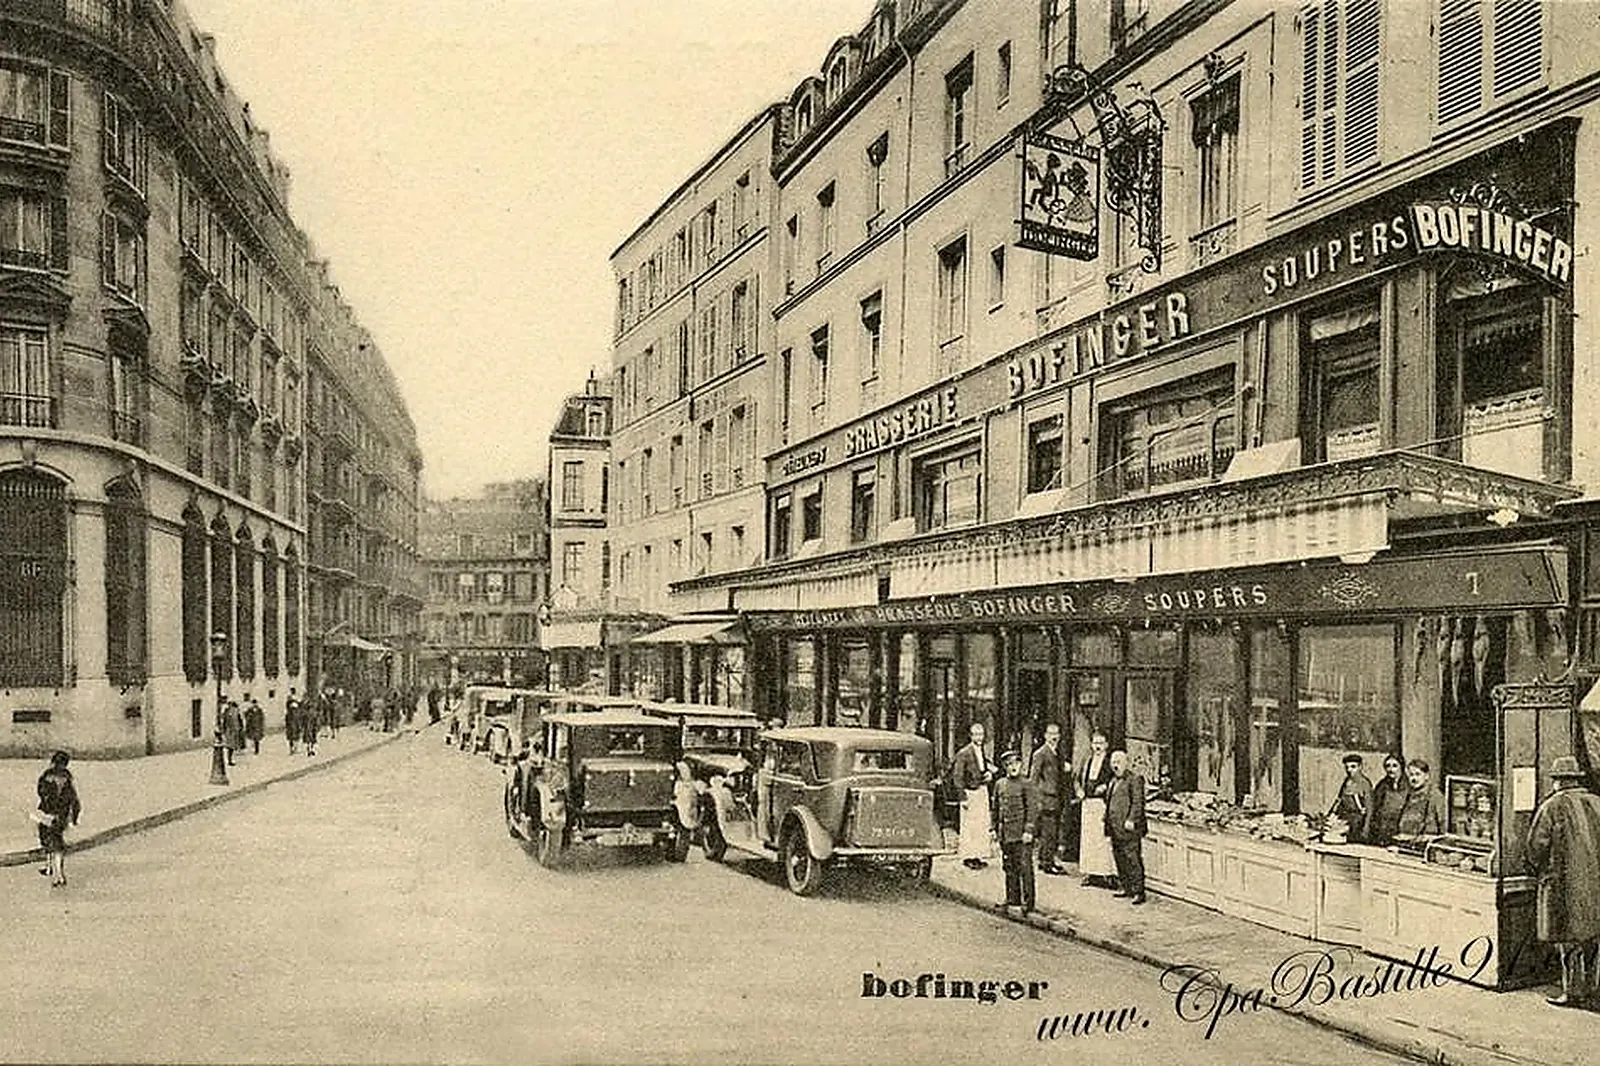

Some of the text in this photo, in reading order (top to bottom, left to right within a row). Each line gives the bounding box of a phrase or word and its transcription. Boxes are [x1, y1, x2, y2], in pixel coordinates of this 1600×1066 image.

[1413, 204, 1574, 283] BOFINGER
[844, 214, 1409, 458] BRASSERIE BOFINGER SOUPERS
[971, 594, 1077, 618] BOFINGER
[1143, 584, 1269, 612] SOUPERS
